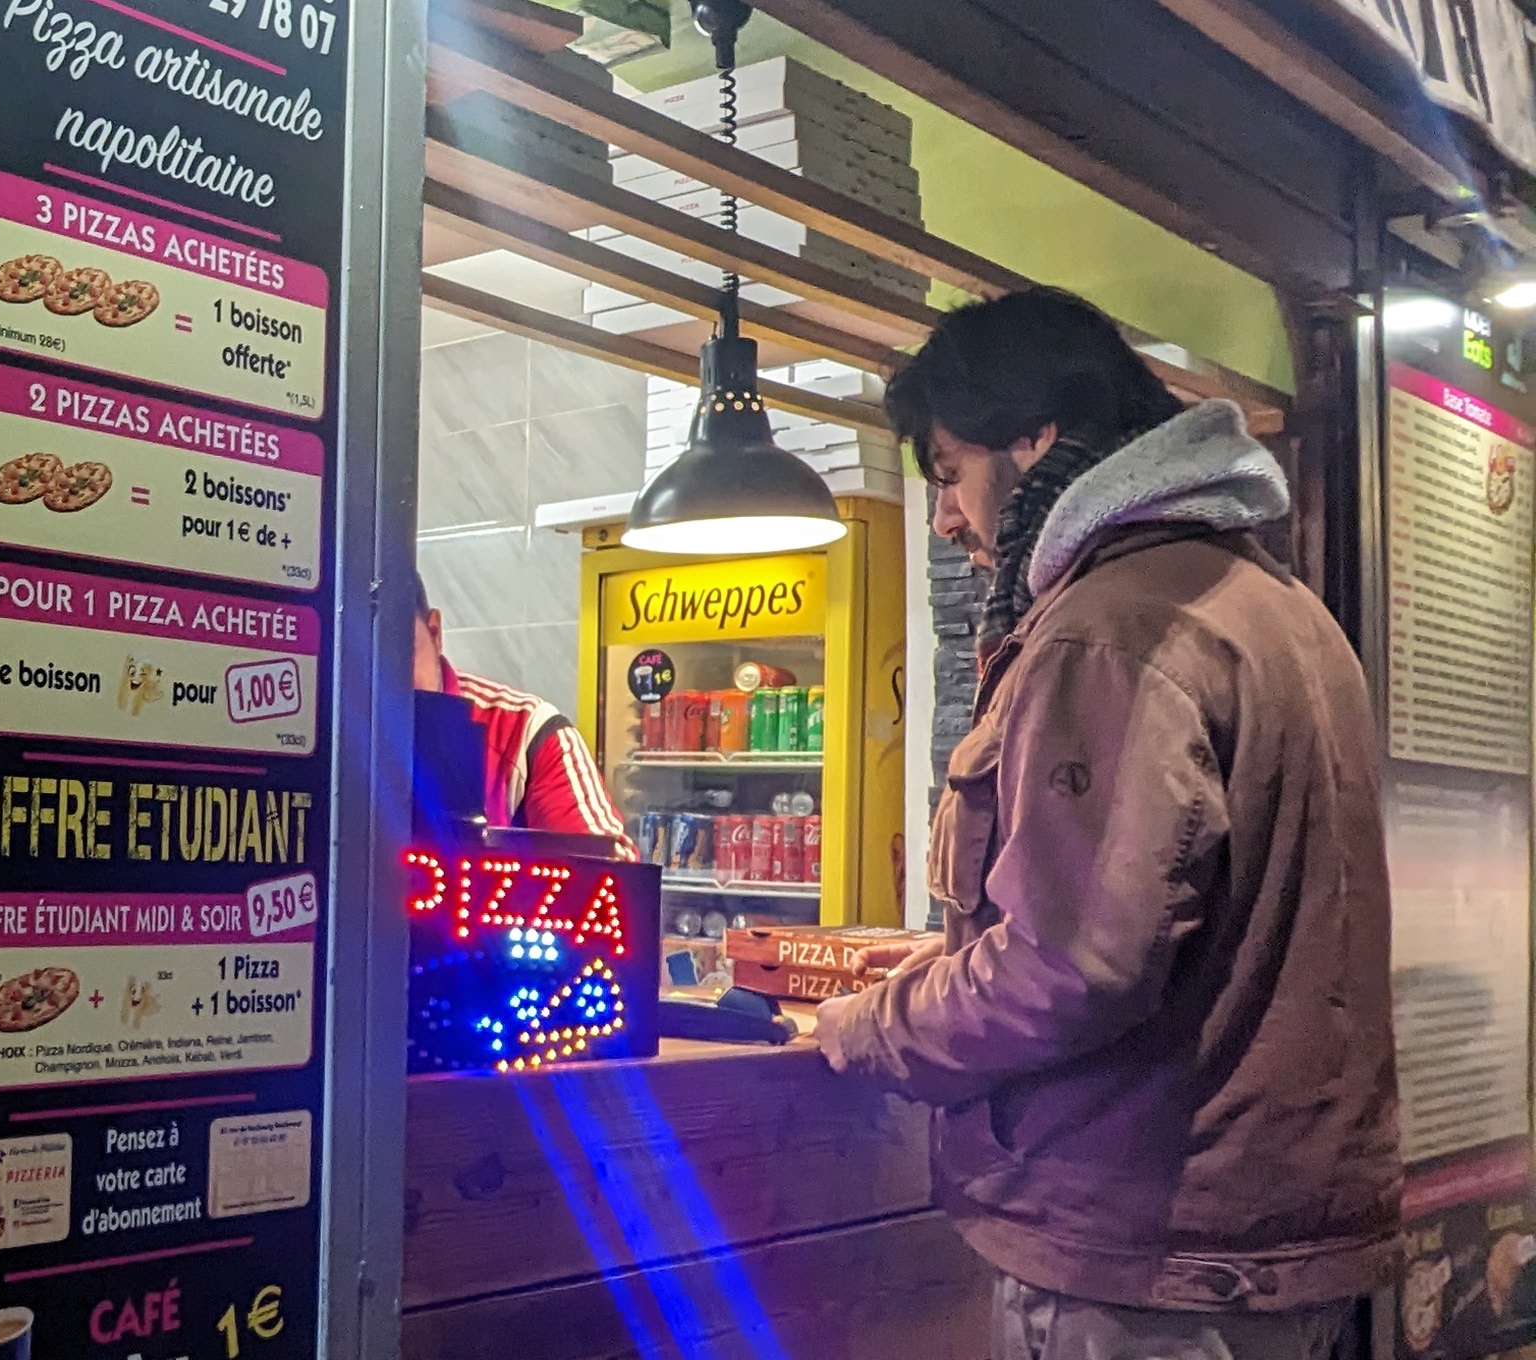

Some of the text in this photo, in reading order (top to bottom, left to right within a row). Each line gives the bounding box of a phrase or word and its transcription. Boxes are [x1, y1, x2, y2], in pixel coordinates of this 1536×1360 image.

[301, 8, 337, 55] 07
[135, 45, 324, 141] artisanale
[54, 106, 275, 208] napolitaine
[35, 194, 285, 290] 3 PIZZAS ACHETÉES
[214, 299, 302, 345] 1 boisson
[28, 383, 280, 461] 2 PIZZAS ACHETÉES
[184, 468, 197, 497] 2
[182, 513, 223, 538] pour
[256, 522, 277, 549] de
[83, 590, 95, 617] 1
[109, 590, 185, 628] PIZZA
[191, 604, 298, 641] ACHETÉE
[621, 578, 806, 632] Schweppes
[19, 659, 101, 694] boisson
[172, 680, 218, 706] pour
[128, 783, 313, 864] ETUDIANT
[34, 898, 131, 934] ÉTUDIANT
[135, 905, 175, 933] MIDI
[180, 909, 194, 931] &
[199, 904, 242, 931] SOIR
[218, 955, 280, 980] 1 Pizza
[779, 940, 837, 967] PIZZA
[209, 991, 220, 1017] 1
[106, 1121, 180, 1154] Pensez à
[96, 1161, 187, 1192] votre carte
[81, 1197, 202, 1235] d'abonnement
[89, 1277, 182, 1344] CAFÉ
